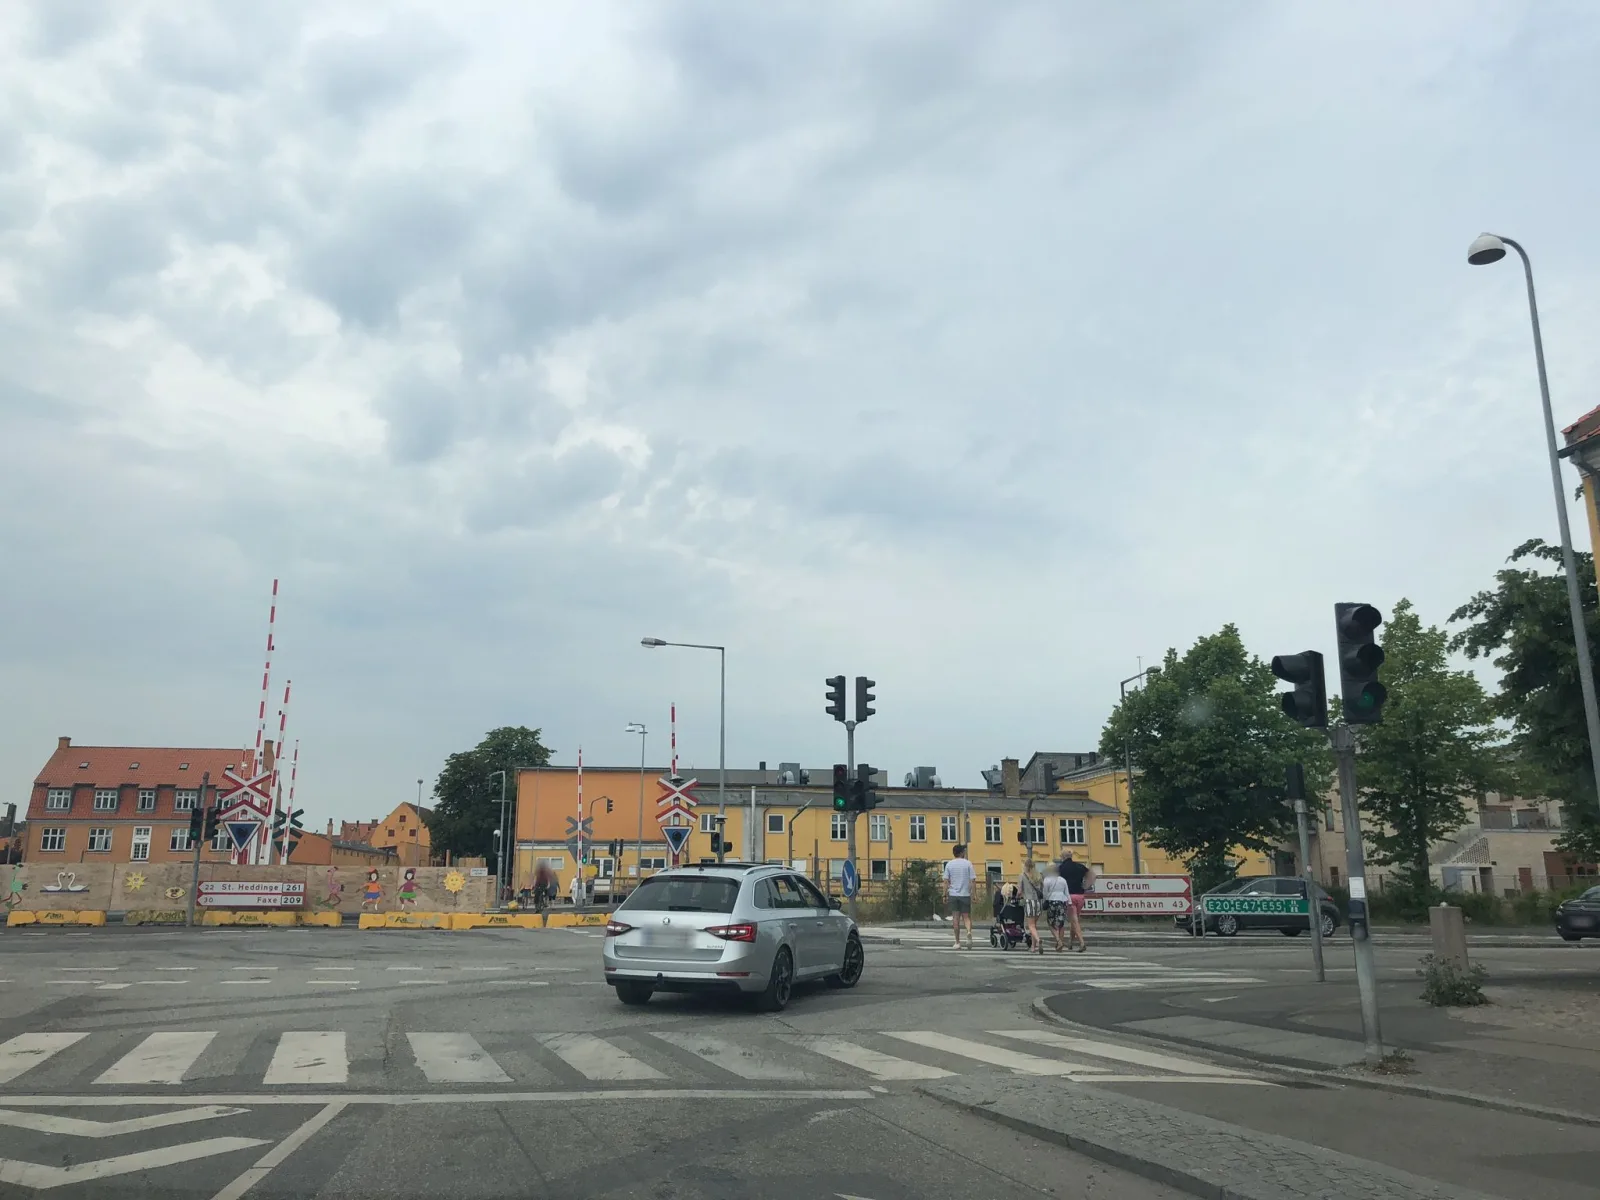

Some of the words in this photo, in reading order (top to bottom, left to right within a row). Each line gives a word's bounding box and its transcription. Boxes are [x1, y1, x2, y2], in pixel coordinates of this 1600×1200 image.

[221, 883, 234, 891] St.
[238, 883, 279, 892] Heddinge
[1106, 881, 1150, 890] Centrum
[283, 896, 301, 904] 209
[1107, 900, 1164, 909] København
[1172, 900, 1184, 908] 43
[1208, 901, 1230, 910] E20
[1235, 901, 1256, 910] E47
[1262, 901, 1282, 910] E55
